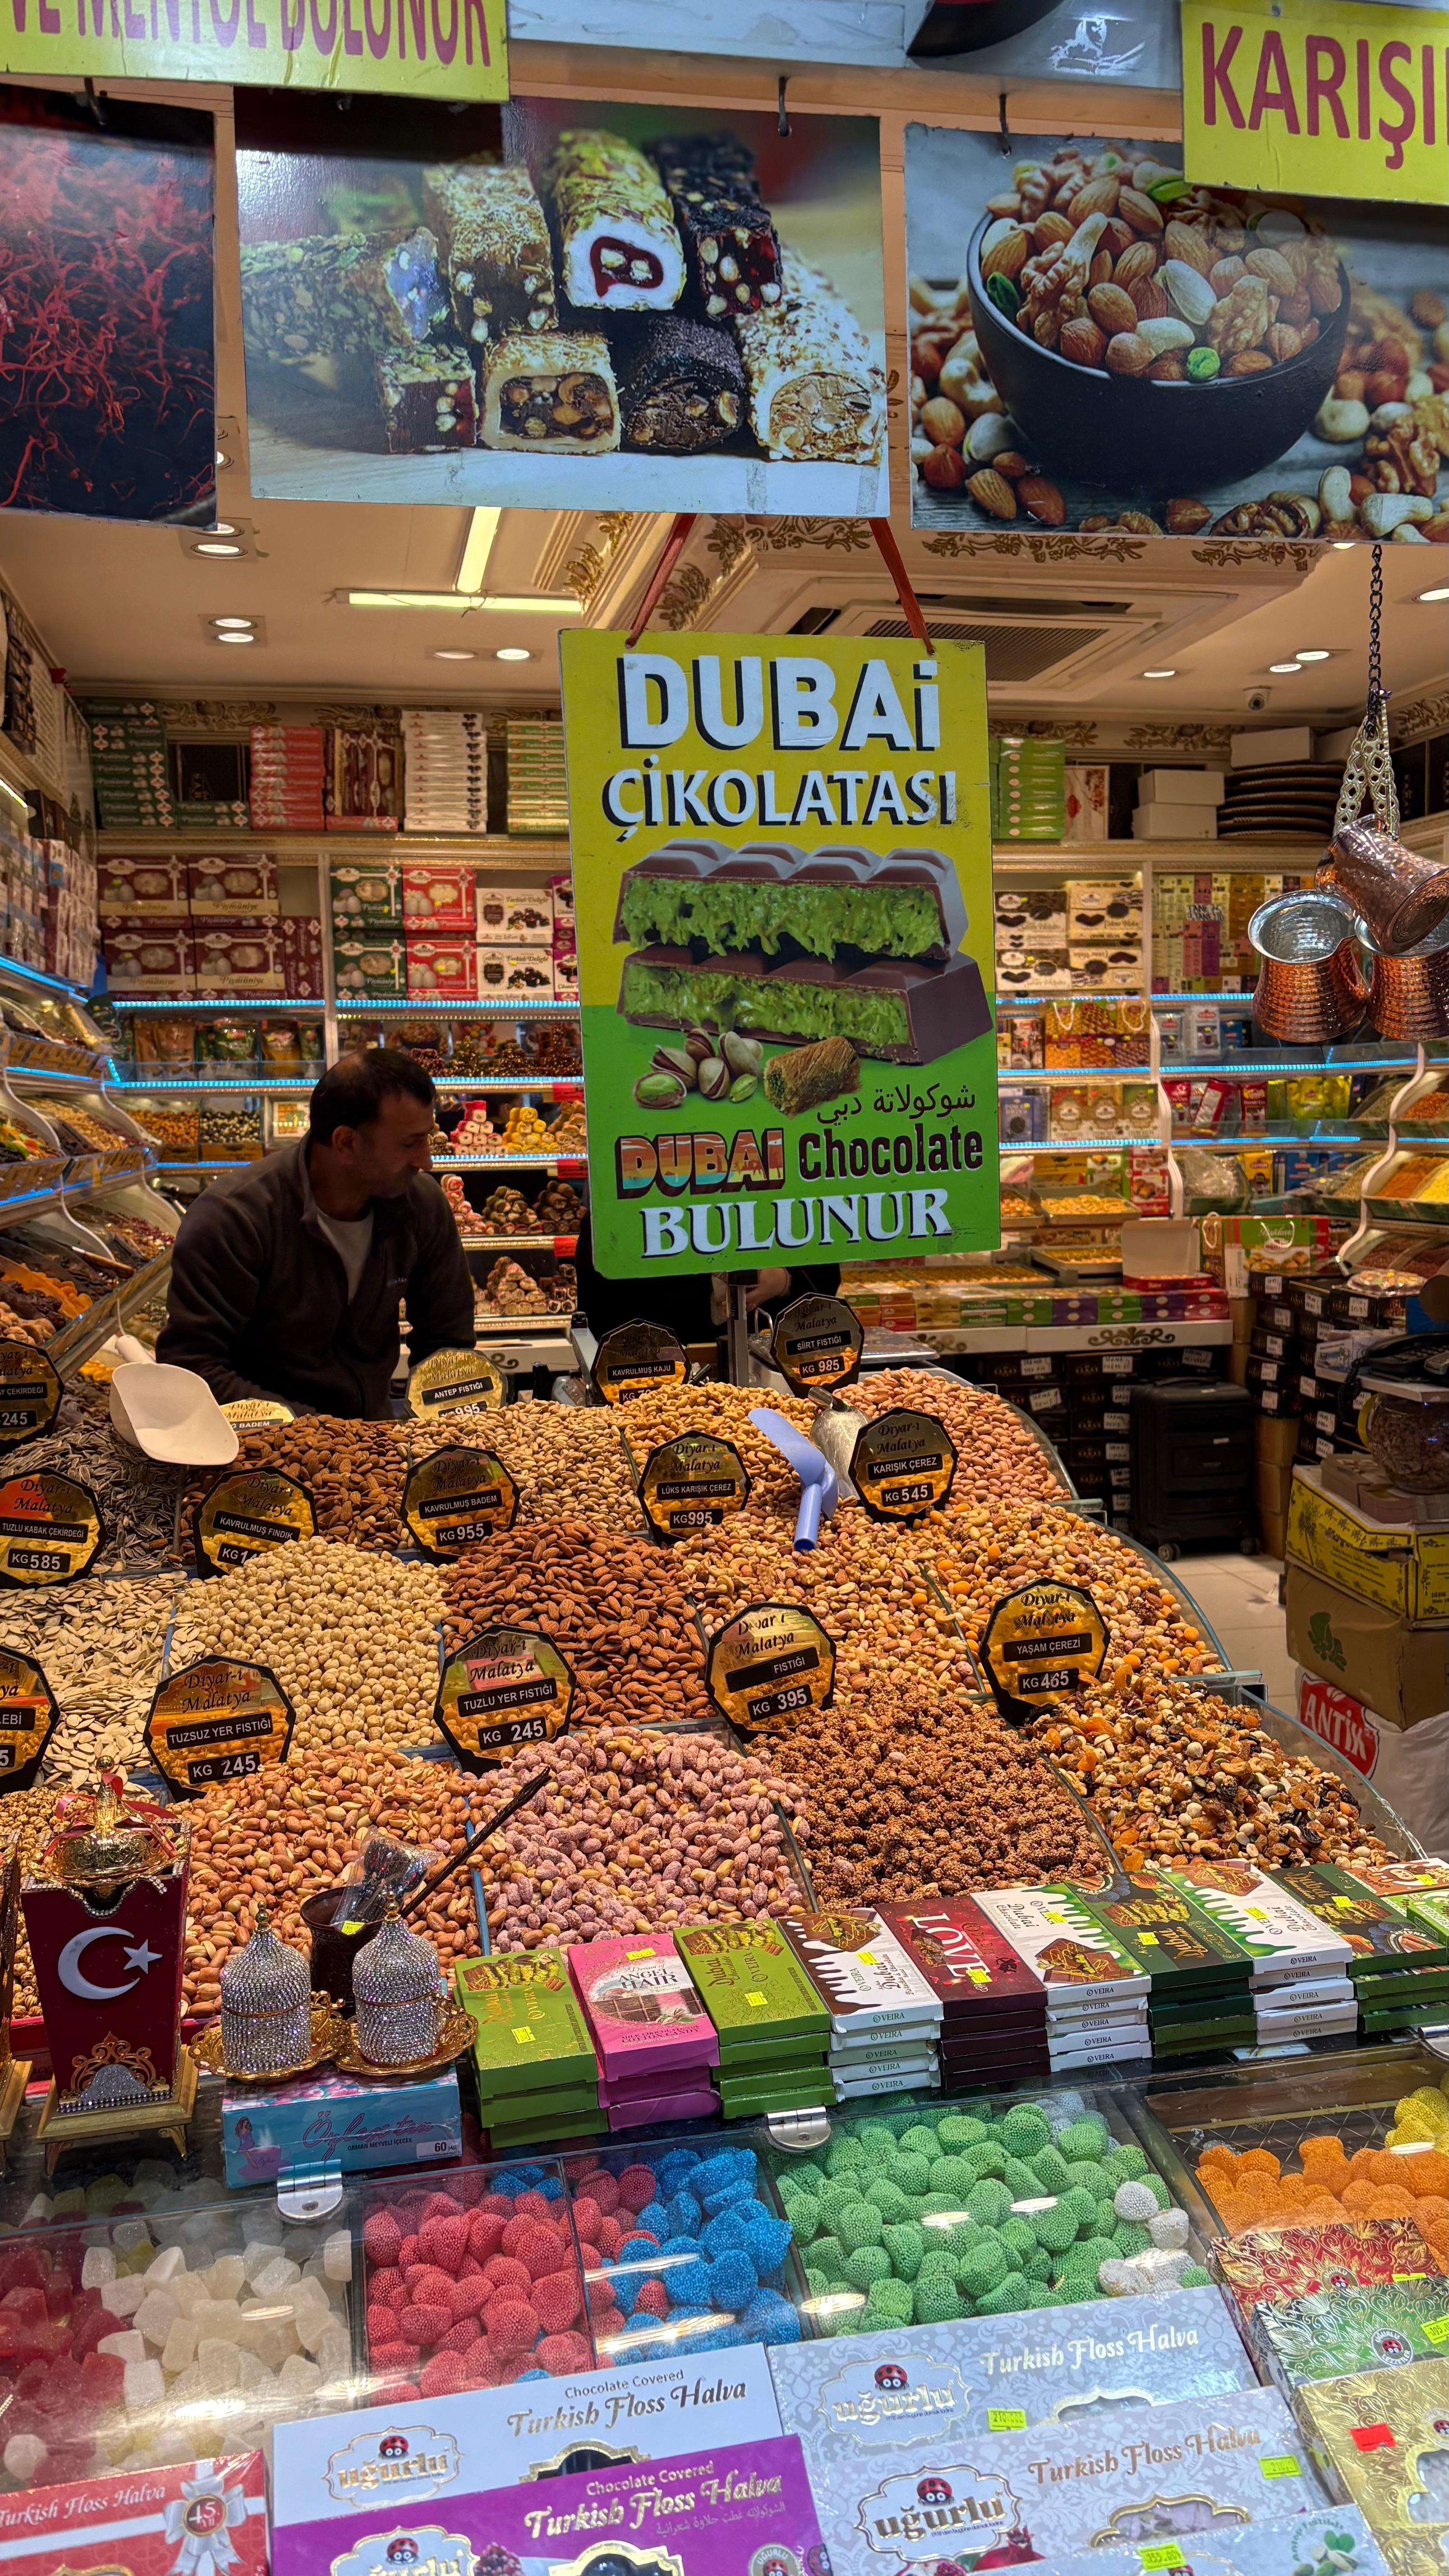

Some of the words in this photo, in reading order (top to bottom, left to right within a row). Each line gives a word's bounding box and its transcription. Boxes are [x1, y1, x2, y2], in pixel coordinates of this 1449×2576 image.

[1202, 23, 1449, 170] KARIŞI
[602, 753, 957, 842] ÇİKOLATASI
[815, 1094, 861, 1127] دبي
[615, 1128, 784, 1199] DUBAI
[798, 1123, 983, 1181] Chocolate
[639, 1189, 952, 1258] BULUNUR
[794, 1316, 837, 1331] Malatya
[817, 1335, 842, 1347] FISTIĞI
[612, 1367, 652, 1376] KAVRULMUŞ
[802, 1365, 815, 1374] KG
[819, 1359, 840, 1372] 985
[7, 1385, 44, 1395] ÇEKİRDEĞİ
[434, 1389, 457, 1399] ANTEP
[459, 1382, 483, 1394] FISTIĞI
[623, 1392, 635, 1401] KG
[2, 1412, 28, 1426] 245
[877, 1439, 925, 1454] Malatya
[874, 1462, 907, 1474] KARIŞIK
[909, 1457, 937, 1470] ÇEREZ
[433, 1474, 487, 1491] Malatya
[662, 1486, 679, 1494] LÜKS
[681, 1485, 708, 1494] KARIŞIK
[709, 1484, 731, 1493] ÇEREZ
[885, 1493, 899, 1502] KG
[902, 1485, 928, 1501] 545
[13, 1497, 73, 1517] Malatya
[238, 1494, 293, 1517] Malatya
[425, 1500, 469, 1513] KAVRULMUŞ
[471, 1495, 497, 1505] BADEM
[673, 1515, 687, 1523] KG
[688, 1512, 713, 1525] 995
[2, 1523, 23, 1532] TUZLU
[24, 1525, 47, 1534] KABAK
[49, 1527, 84, 1538] ÇEKİRDEĞİ
[220, 1517, 266, 1535] KAVRULMUŞ
[268, 1527, 293, 1540] FINDIK
[440, 1531, 455, 1541] KG
[457, 1523, 484, 1540] 955
[12, 1553, 28, 1564] KG
[30, 1555, 60, 1570] 585
[222, 1548, 239, 1559] KG
[736, 1632, 794, 1660] Malatya
[1017, 1643, 1047, 1656] YAŞAM
[1049, 1637, 1081, 1653] ÇEREZİ
[469, 1660, 534, 1683] Malatya
[774, 1656, 805, 1674] FISTIĞI
[1023, 1678, 1039, 1688] KG
[1041, 1670, 1069, 1688] 465
[182, 1691, 251, 1713] Malatya
[464, 1696, 495, 1711] TUZLU
[497, 1692, 517, 1704] YER
[520, 1684, 552, 1700] FISTIĞI
[753, 1702, 770, 1715] KG
[777, 1688, 807, 1710] 395
[170, 1730, 210, 1744] TUZSUZ
[212, 1726, 233, 1737] YER
[236, 1718, 271, 1734] FISTIĞI
[483, 1730, 501, 1744] KG
[511, 1720, 543, 1741] 245
[1304, 1693, 1366, 1761] ANTİK
[193, 1764, 212, 1777] KG
[221, 1755, 256, 1776] 245
[911, 1913, 991, 1977] LOVE
[619, 1969, 673, 1982] ANGEL
[621, 1974, 679, 1989] HAIR
[1298, 1992, 1319, 2000] VEIRA
[881, 2012, 905, 2021] VEIRA
[1302, 2012, 1322, 2021] VEIRA
[878, 2030, 902, 2040] VEIRA
[1092, 2036, 1112, 2044] VEIRA
[1300, 2028, 1322, 2036] VEIRA
[873, 2048, 897, 2058] VEIRA
[1094, 2053, 1114, 2061] VEIRA
[876, 2062, 901, 2072] VEIRA
[879, 2079, 903, 2089] VEIRA
[434, 2142, 446, 2152] 60
[979, 2344, 1064, 2376] Turkish
[1066, 2336, 1124, 2371] Floss
[1127, 2323, 1199, 2355] Halva
[565, 2378, 630, 2399] Chocolate
[632, 2369, 685, 2387] Covered
[507, 2400, 600, 2436] Turkish
[604, 2393, 665, 2428] Floss
[670, 2374, 747, 2407] Halva
[833, 2383, 957, 2426] uğurlu
[1027, 2452, 1119, 2485] Turkish
[1121, 2443, 1182, 2476] Floss
[1185, 2426, 1260, 2458] Halva
[338, 2452, 449, 2490] uğurlu
[586, 2475, 656, 2497] Chocolate
[659, 2460, 714, 2484] Covered
[0, 2504, 59, 2526] Turkish
[62, 2495, 108, 2521] Floss
[113, 2484, 166, 2511] Halva
[524, 2504, 625, 2539] Turkish
[629, 2490, 696, 2529] Floss
[699, 2470, 782, 2507] Halva
[874, 2497, 1007, 2542] uğurlu
